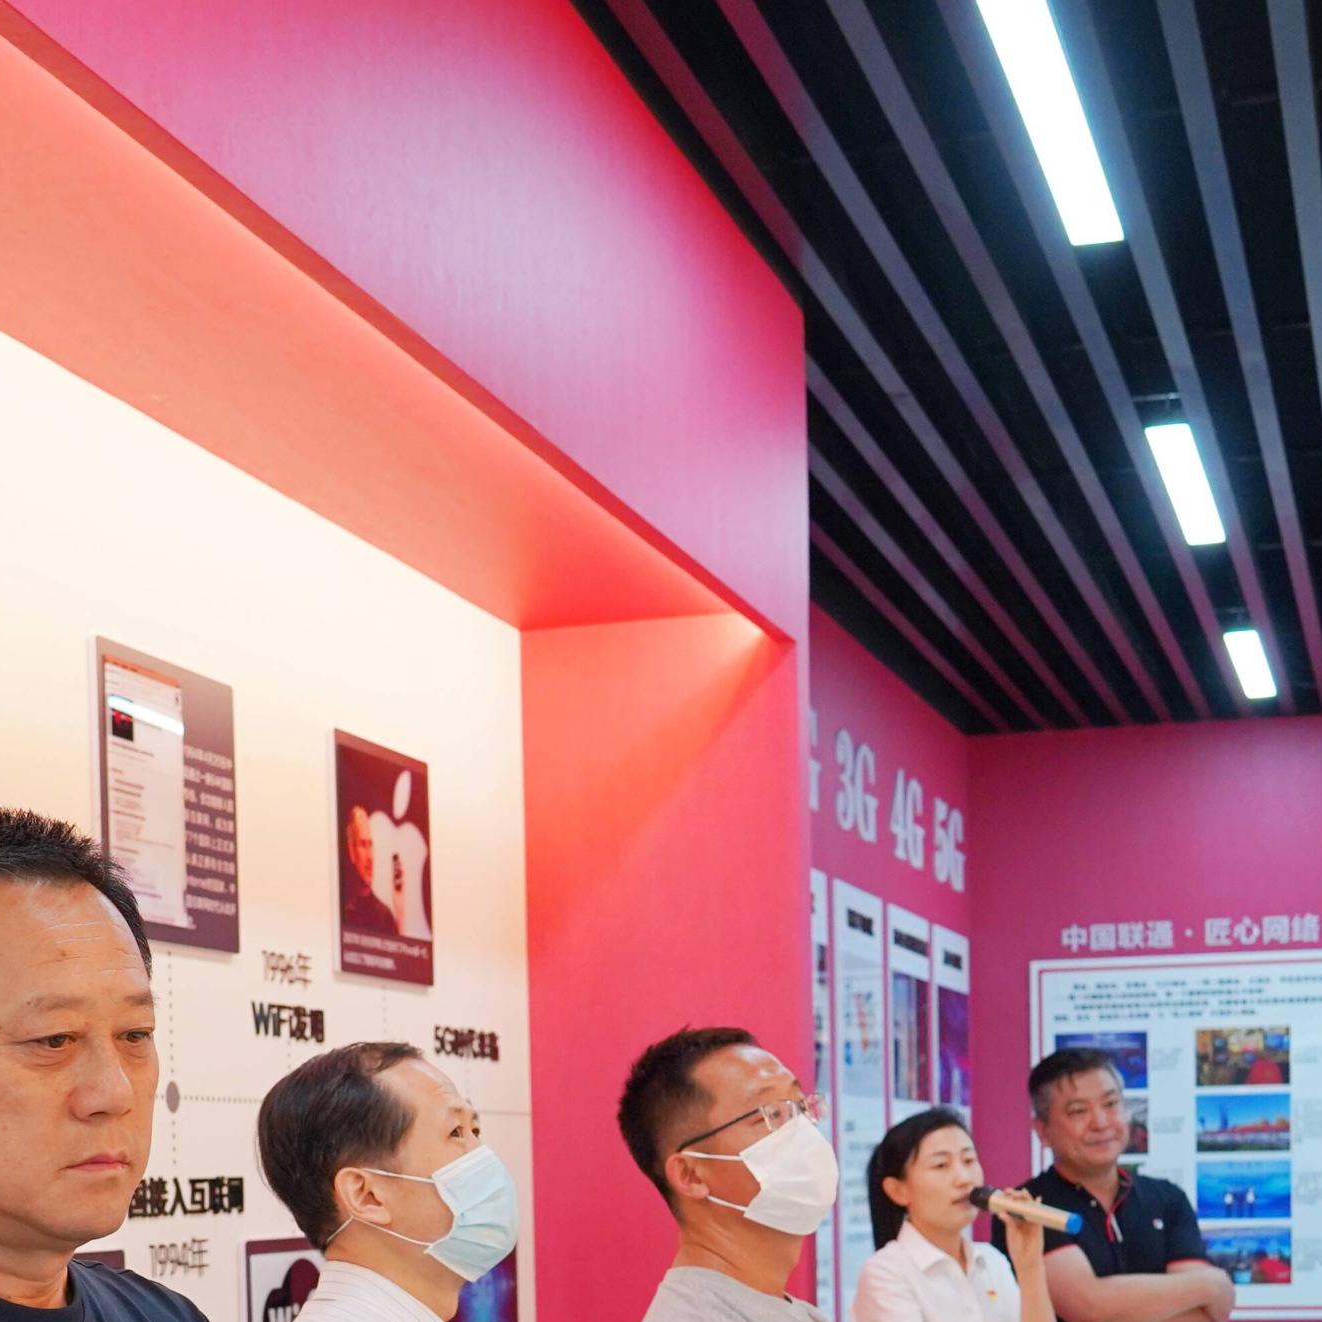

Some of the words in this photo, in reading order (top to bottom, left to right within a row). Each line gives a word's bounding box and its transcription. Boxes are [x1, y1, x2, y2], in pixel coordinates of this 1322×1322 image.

[835, 727, 878, 844] 3G
[890, 768, 926, 870] 4G
[933, 796, 966, 893] 5G
